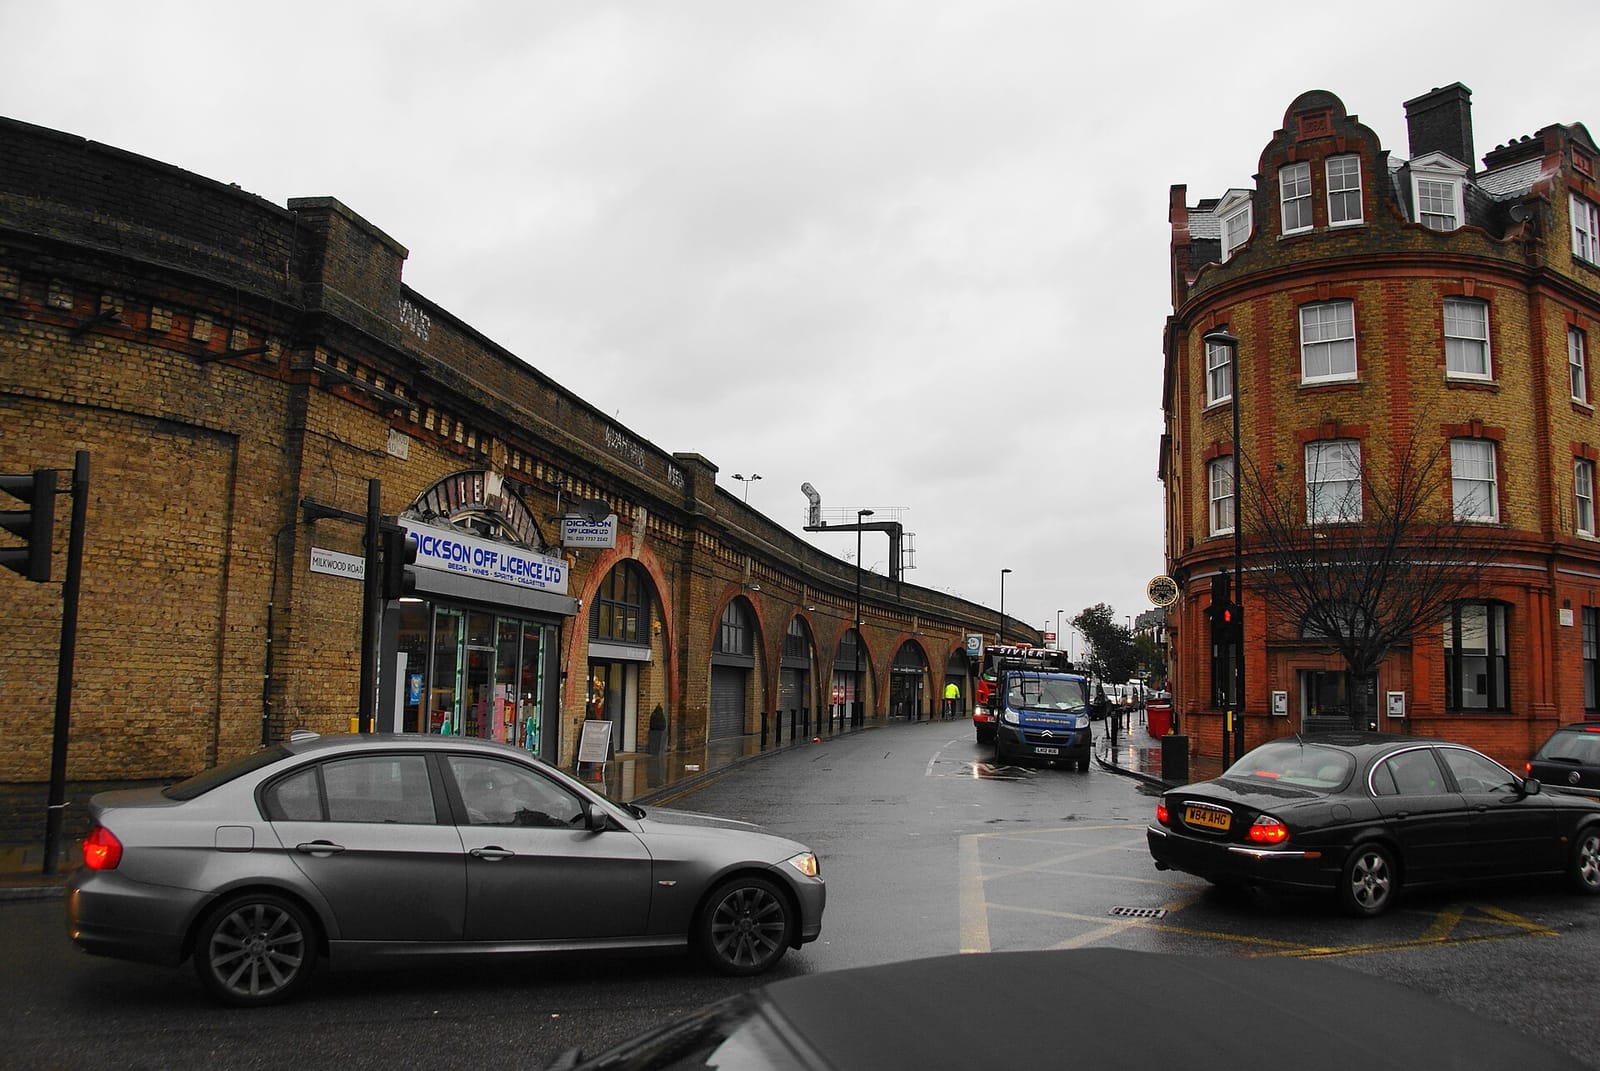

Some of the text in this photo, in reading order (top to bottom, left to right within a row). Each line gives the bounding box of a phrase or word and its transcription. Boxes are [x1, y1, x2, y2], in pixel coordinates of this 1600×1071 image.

[312, 556, 364, 575] MILKWOOD ROAD
[447, 562, 546, 588] BEERS WINES SPIRITS CIGARETTES
[474, 548, 498, 568] OFF
[500, 554, 543, 579] LICENCE
[544, 565, 561, 583] LTD
[1208, 812, 1227, 825] AHG
